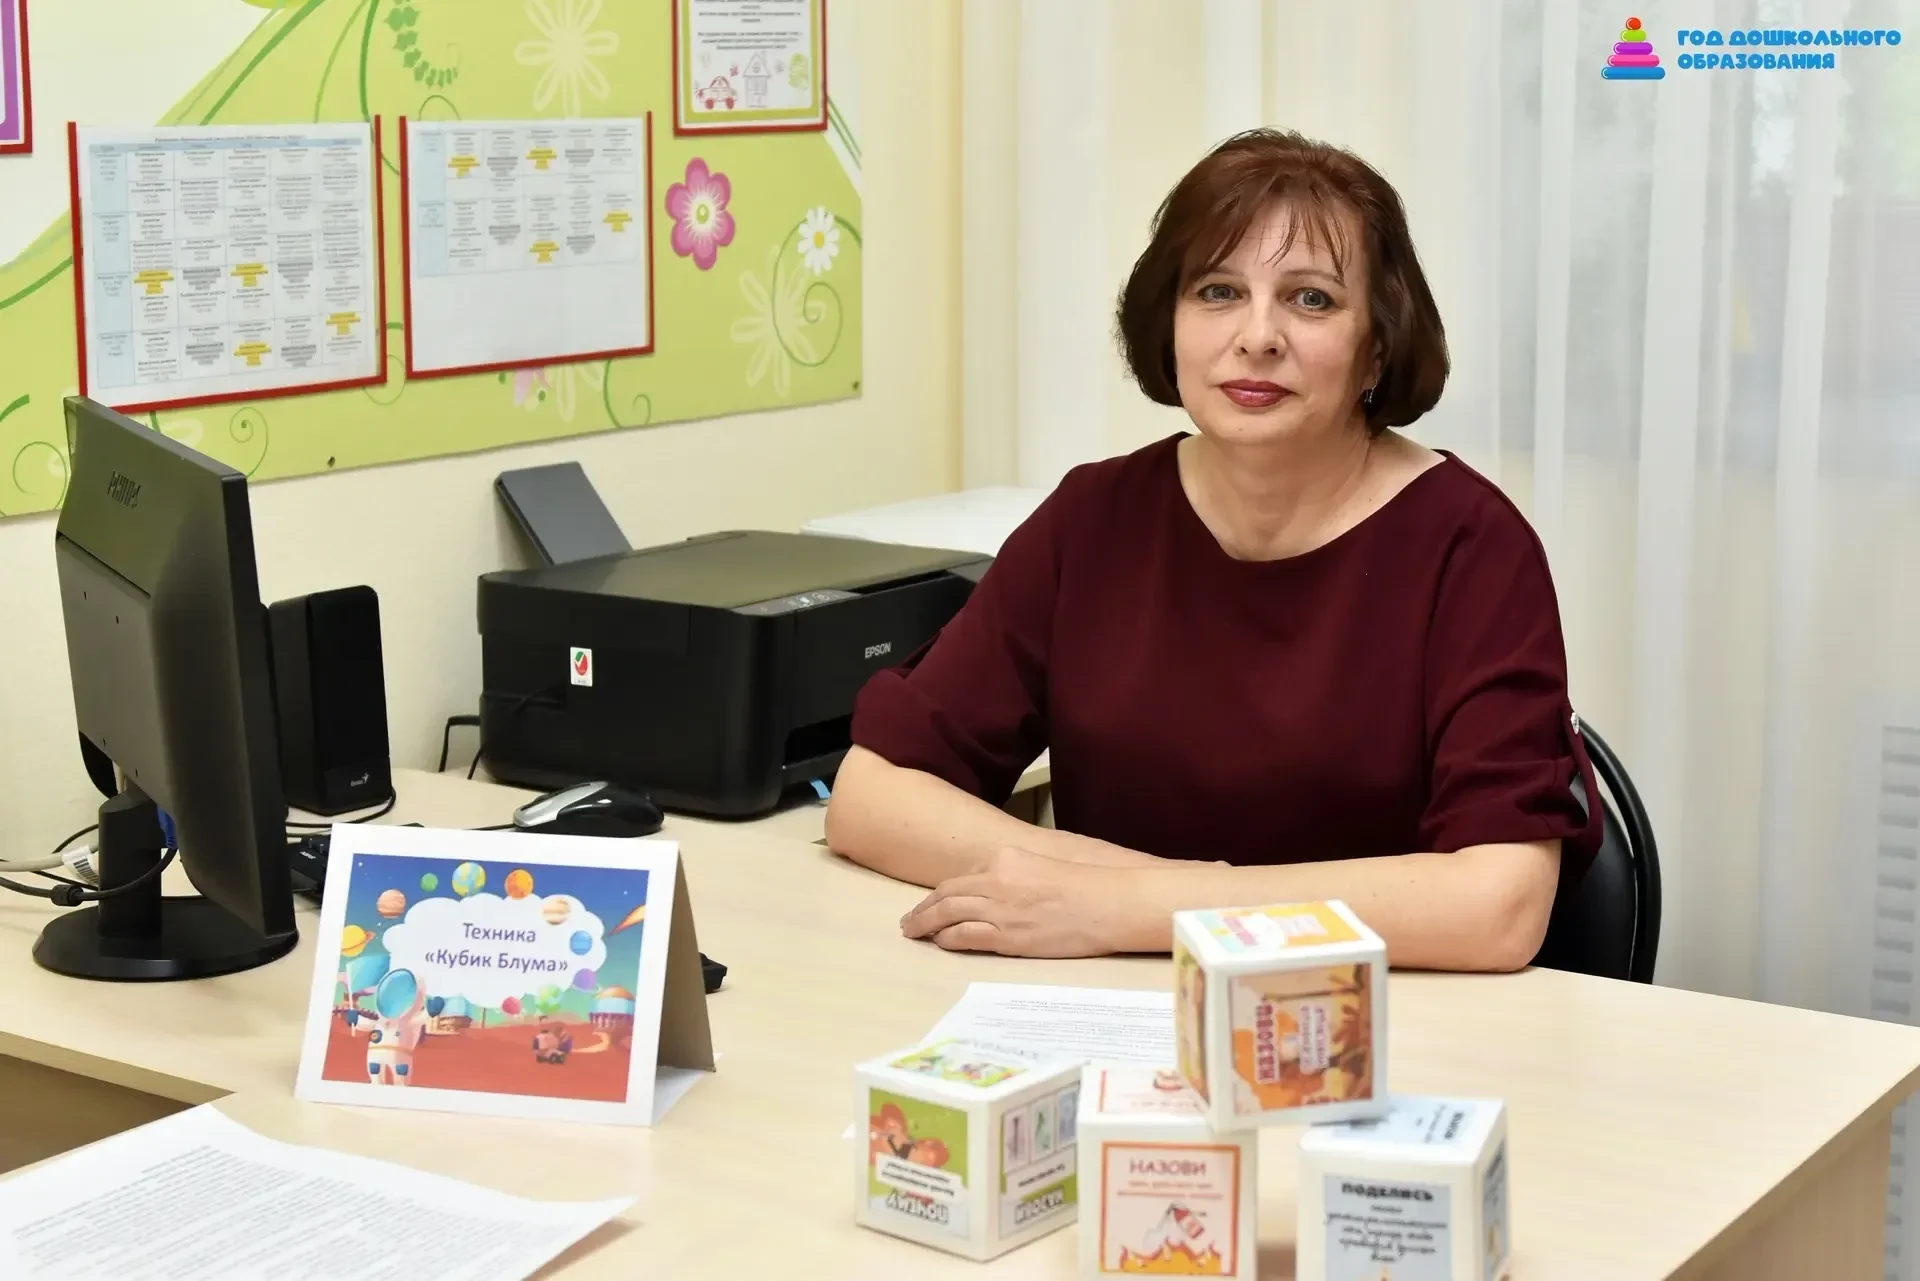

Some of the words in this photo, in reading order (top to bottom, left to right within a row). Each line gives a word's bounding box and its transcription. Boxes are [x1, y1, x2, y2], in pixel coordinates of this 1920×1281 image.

[864, 641, 892, 659] EPSON
[463, 922, 536, 943] Техника
[425, 949, 492, 968] «Кубик
[497, 952, 568, 973] Блума»
[1129, 1158, 1206, 1176] НАЗОВИ
